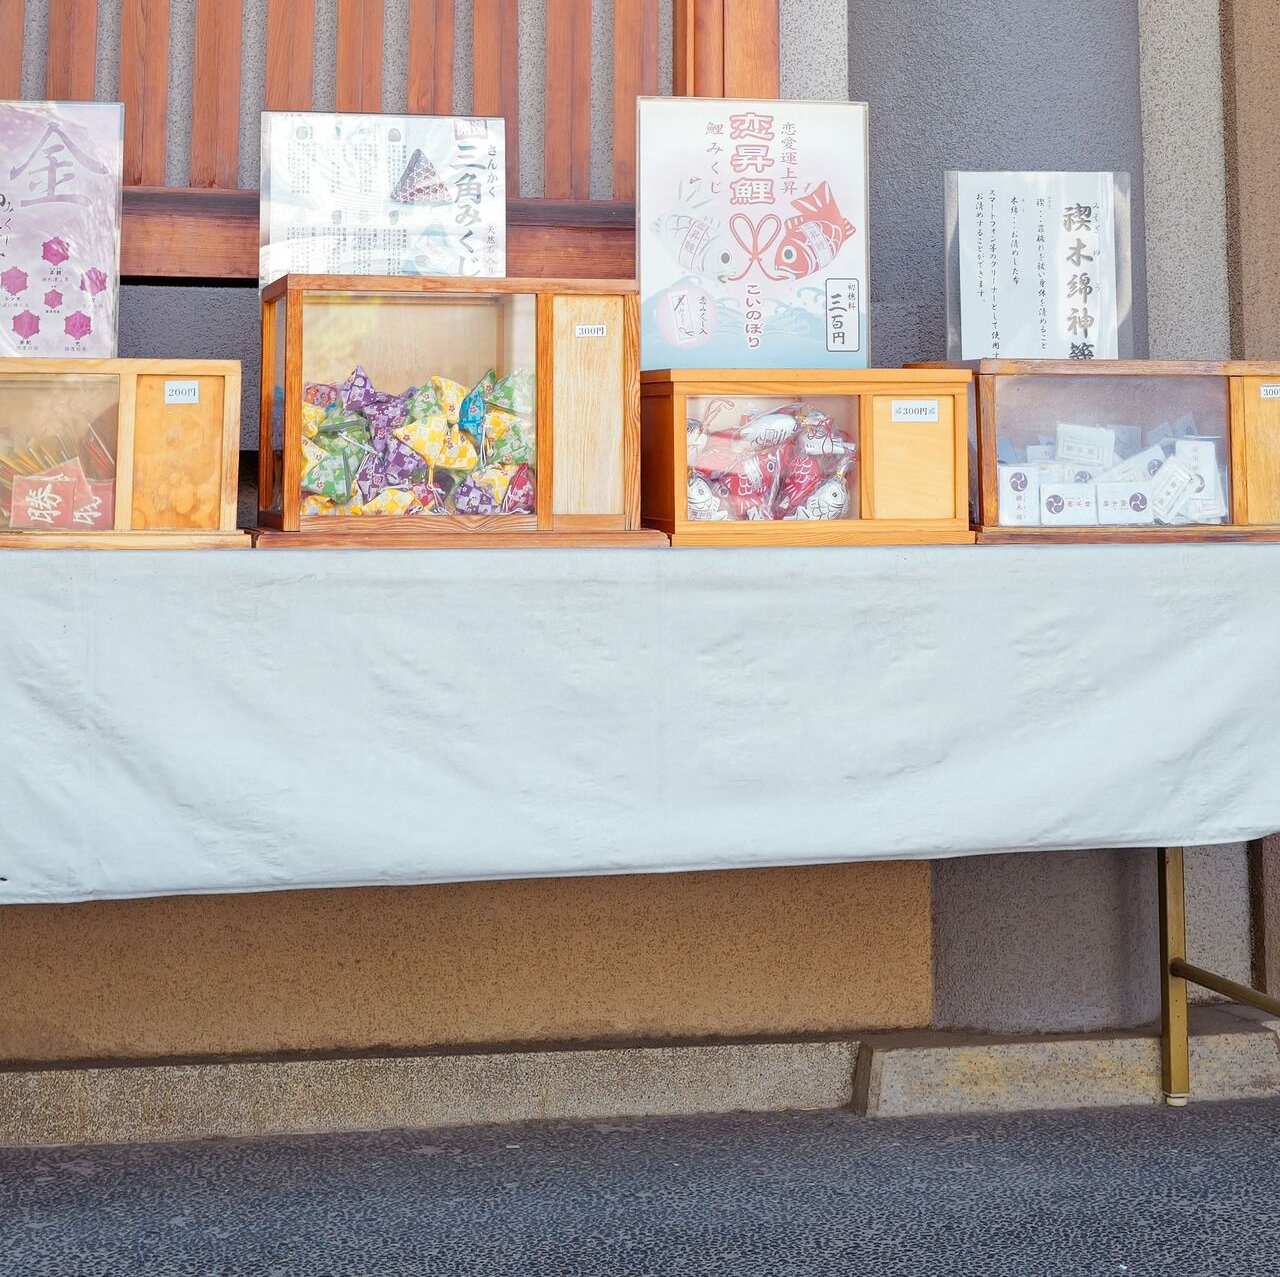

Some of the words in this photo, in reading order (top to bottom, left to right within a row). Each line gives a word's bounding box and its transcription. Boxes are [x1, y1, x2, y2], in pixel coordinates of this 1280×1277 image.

[9, 122, 109, 208] 金
[486, 145, 498, 199] さんかく
[705, 122, 723, 194] 鯉みくじ
[729, 112, 775, 206] 恋昇鯉
[780, 122, 798, 195] 恋愛運上昇
[449, 144, 486, 276] 三角みくじ
[744, 284, 763, 348] こいのぼり
[828, 293, 848, 345] 三百円
[848, 282, 856, 310] 初穂料
[578, 326, 604, 335] 300円
[168, 387, 196, 397] 200円
[903, 407, 928, 416] 300円
[25, 483, 62, 524] 勝
